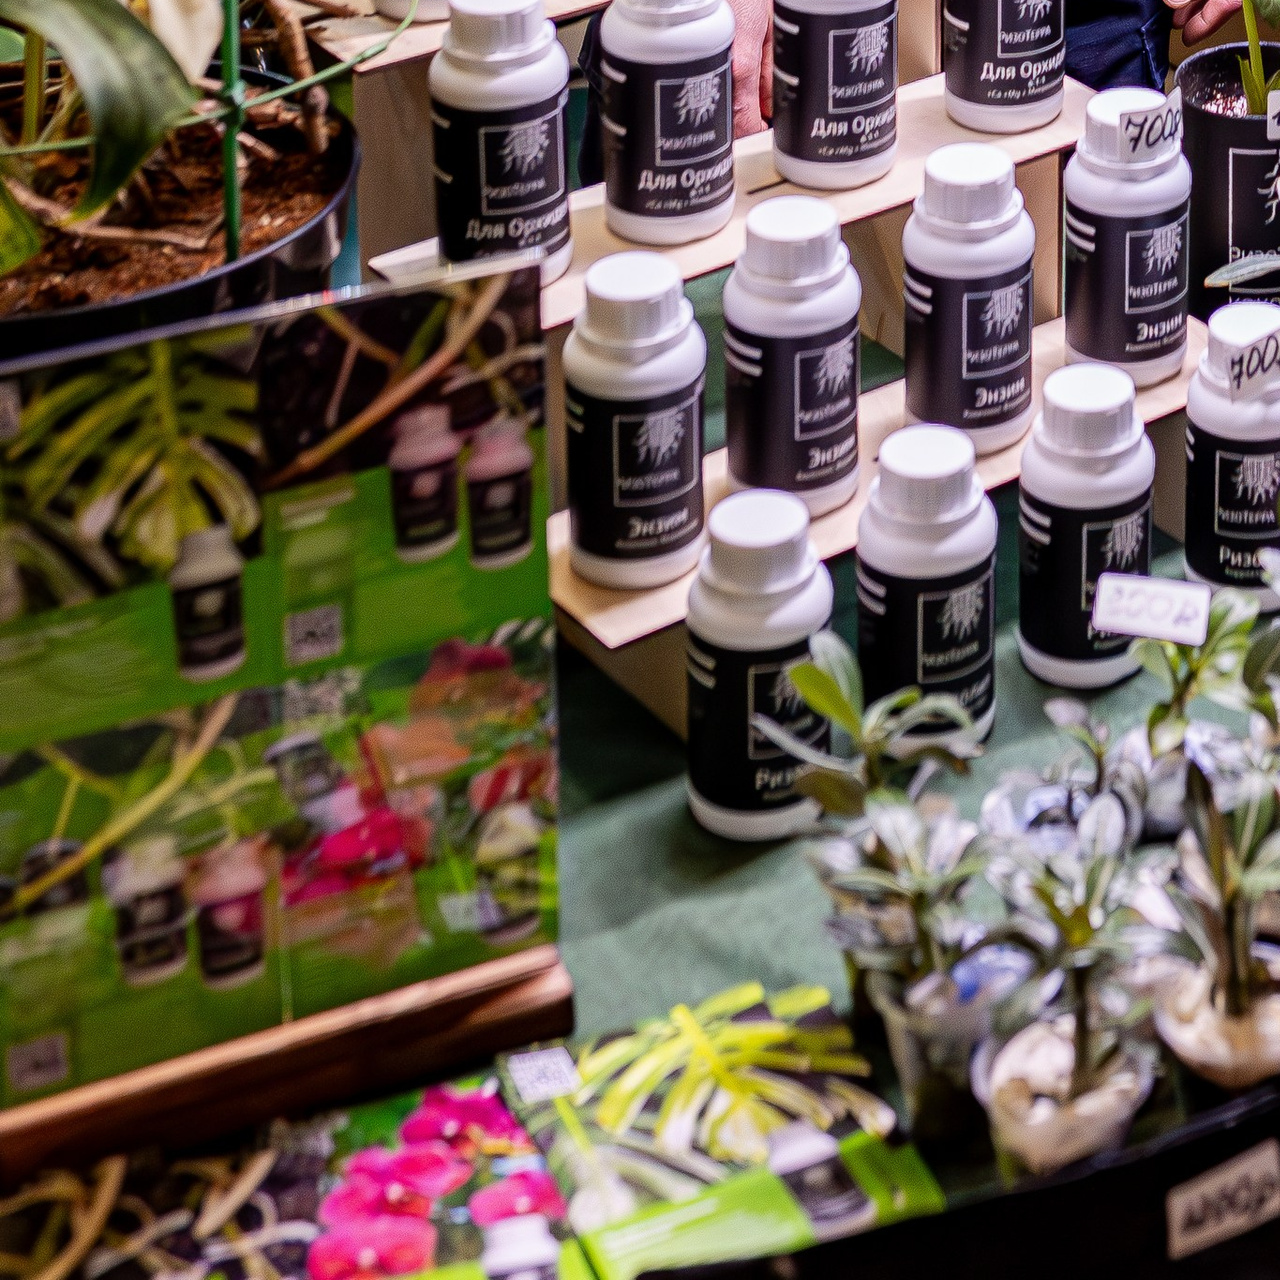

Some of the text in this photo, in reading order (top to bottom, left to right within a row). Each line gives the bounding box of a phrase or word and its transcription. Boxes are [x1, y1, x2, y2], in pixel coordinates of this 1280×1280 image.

[980, 62, 1017, 83] Для
[811, 117, 849, 139] Для
[638, 169, 677, 191] Для
